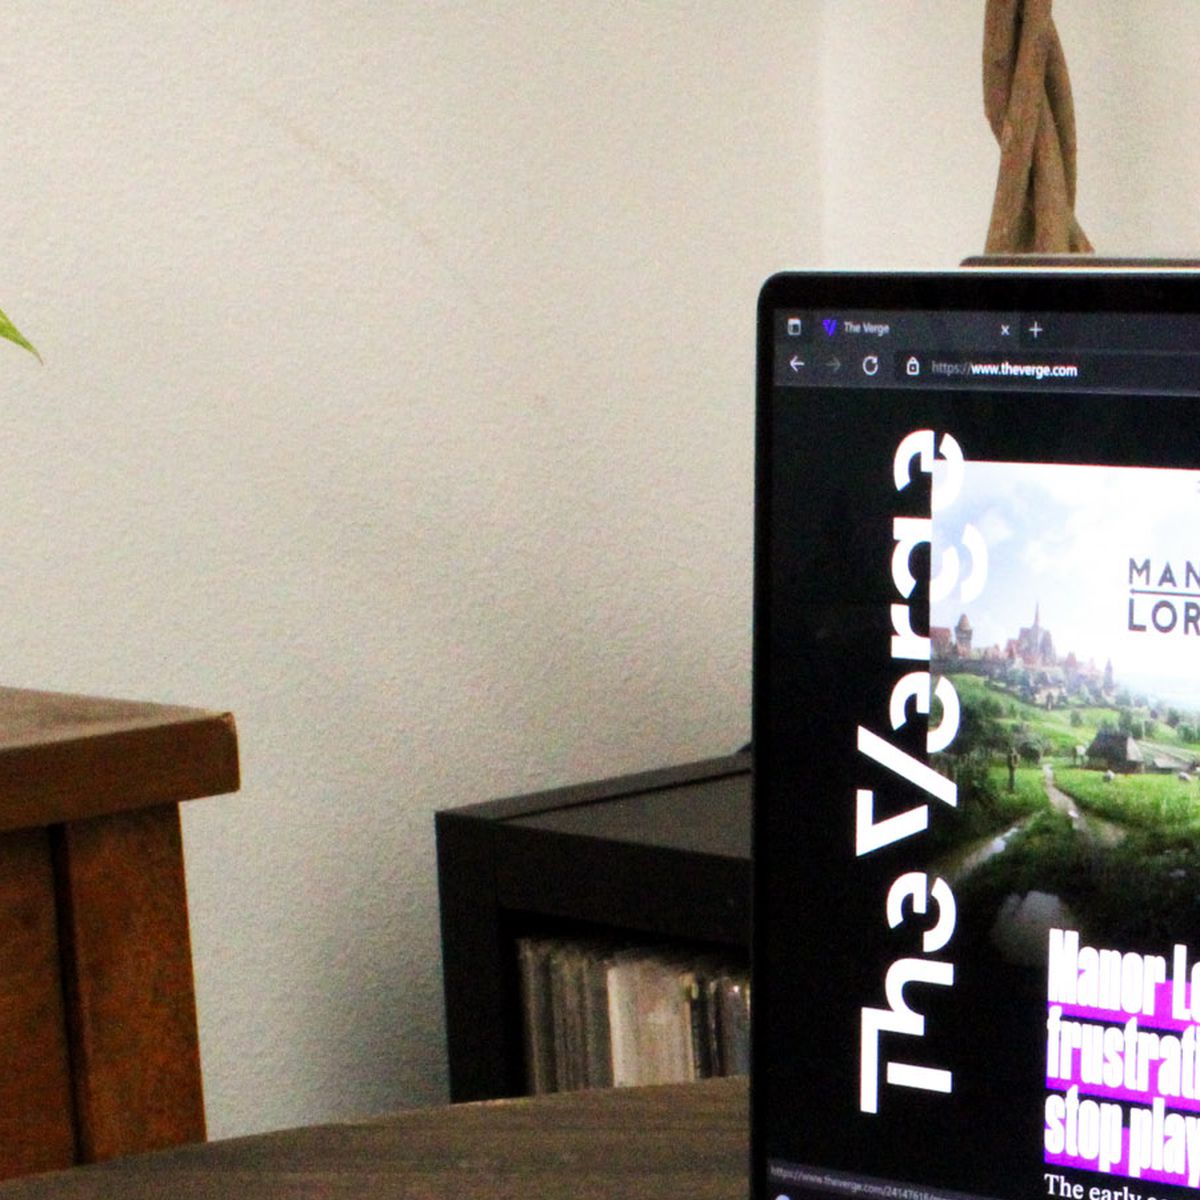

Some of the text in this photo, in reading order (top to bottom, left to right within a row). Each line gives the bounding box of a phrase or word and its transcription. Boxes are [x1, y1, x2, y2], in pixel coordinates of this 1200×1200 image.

[844, 322, 889, 335] The Verge
[932, 362, 1077, 378] https://www.theverge.com
[860, 873, 955, 1114] The
[1048, 928, 1166, 1017] Manor
[1044, 1085, 1123, 1172] stop
